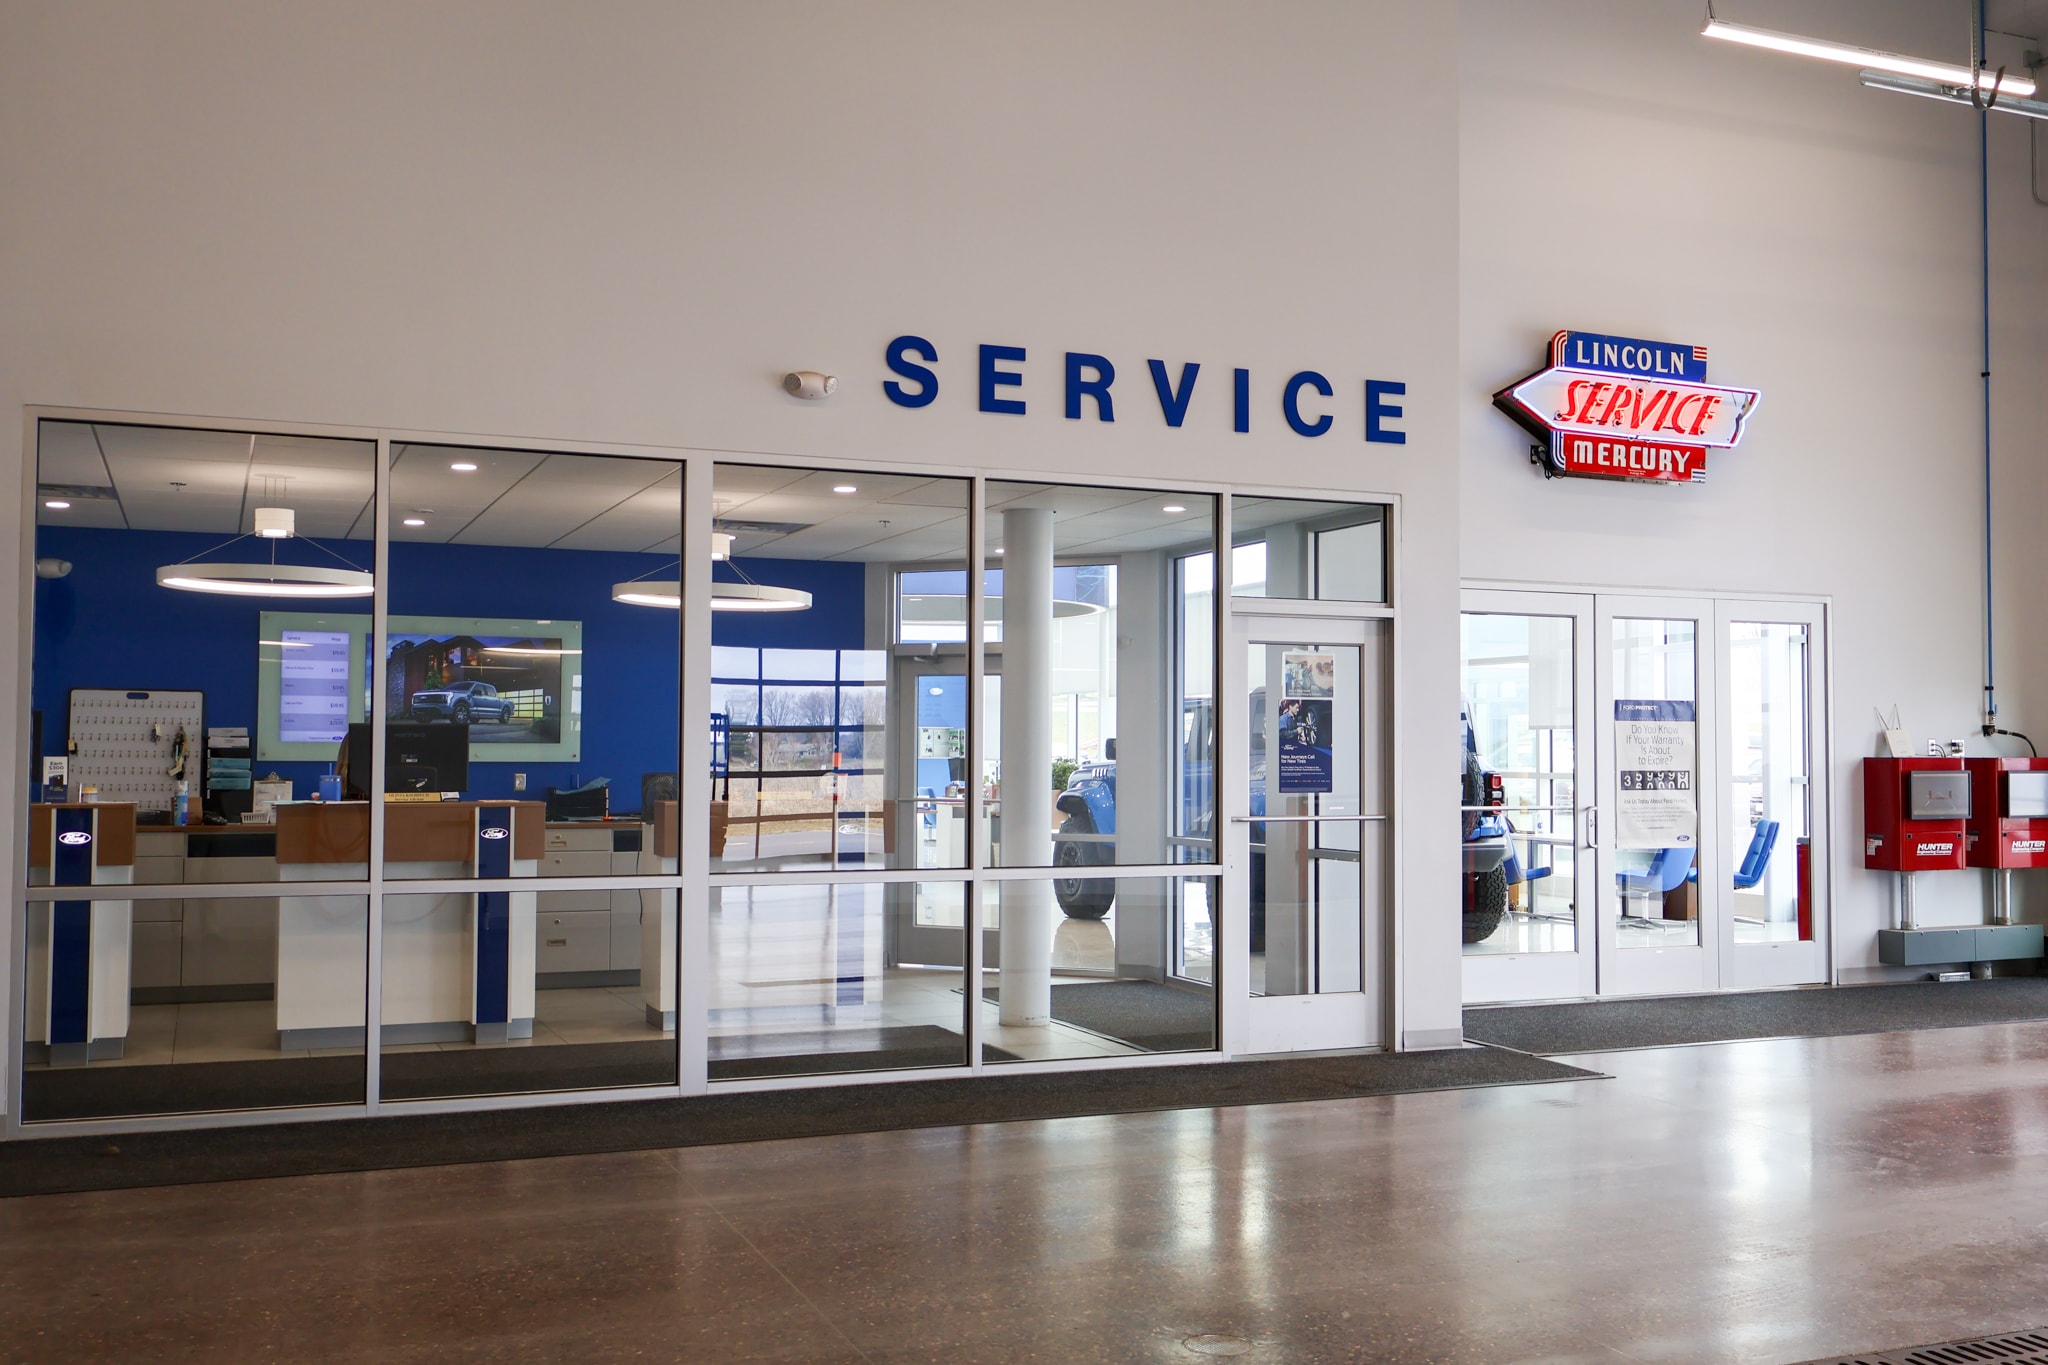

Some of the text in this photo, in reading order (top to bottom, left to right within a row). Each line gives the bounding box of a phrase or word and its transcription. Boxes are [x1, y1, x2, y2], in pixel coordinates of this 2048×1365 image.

[1576, 340, 1685, 375] LINCOLN
[883, 335, 1406, 444] SERVICE
[1553, 379, 1724, 436] SERVICE
[1573, 440, 1691, 472] MERCURY
[1631, 725, 1679, 734] Do You Know
[1626, 735, 1684, 746] If Your Warranty
[1640, 746, 1671, 755] Is About
[1638, 756, 1673, 767] to Expire?
[62, 832, 88, 843] Ford
[1918, 843, 1954, 851] HUNTER
[2012, 840, 2046, 849] HUNTER
